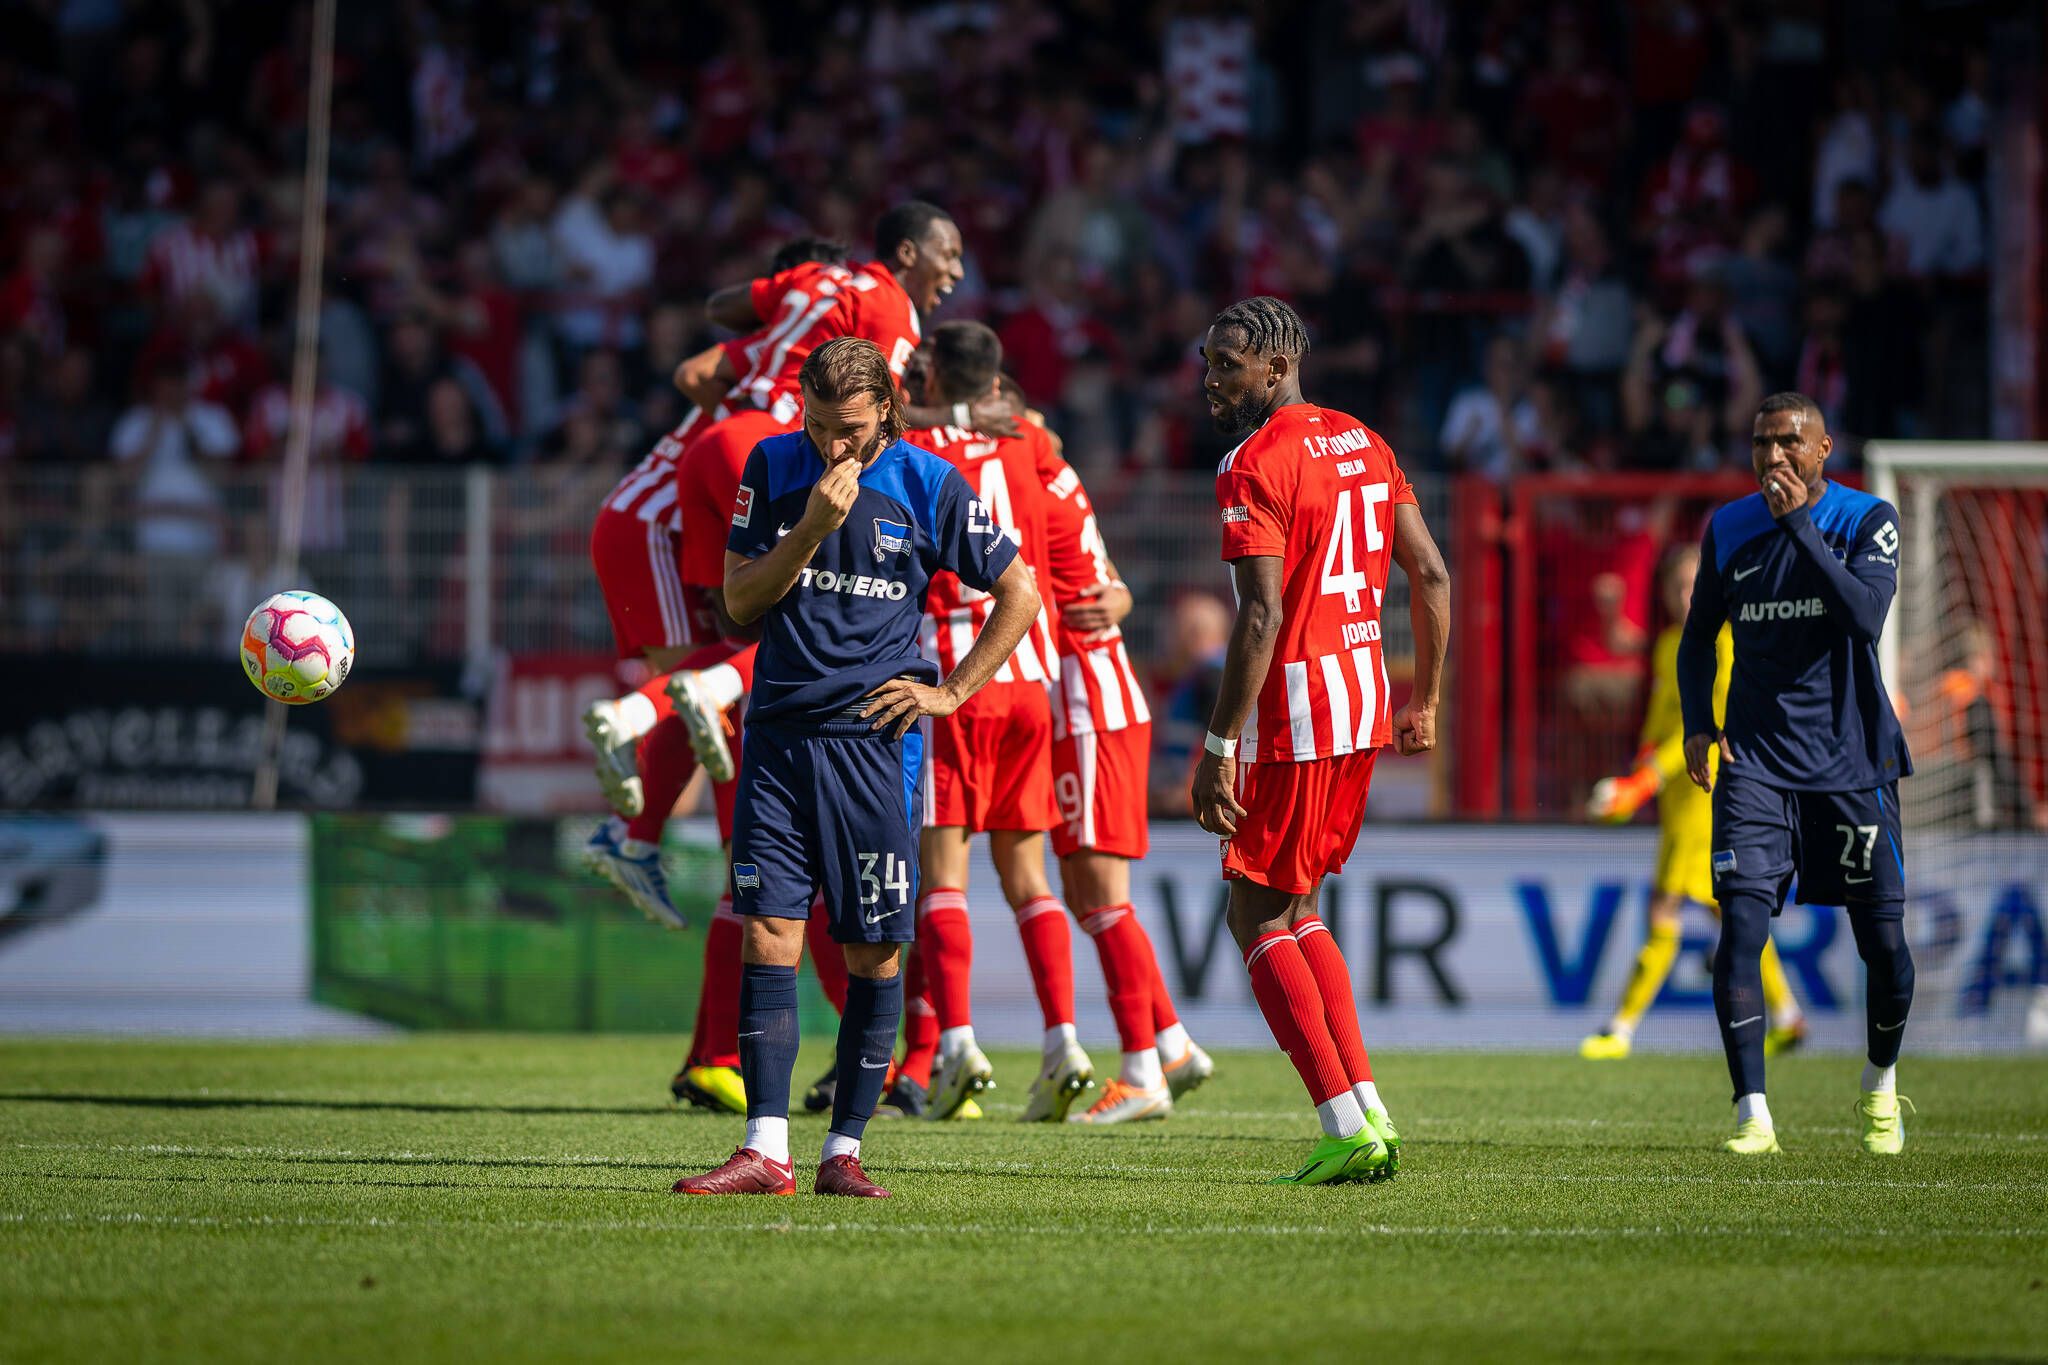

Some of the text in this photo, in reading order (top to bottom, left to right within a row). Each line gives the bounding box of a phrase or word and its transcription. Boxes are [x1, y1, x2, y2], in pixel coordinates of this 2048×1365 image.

[1336, 458, 1367, 478] BERLIN
[1222, 505, 1249, 516] OMEDY
[1222, 513, 1251, 524] ENTRAL
[1321, 482, 1389, 614] 45
[797, 567, 907, 601] TOHERO
[1739, 597, 1827, 622] AUTOHE
[1836, 823, 1879, 871] 27
[858, 852, 910, 905] 34
